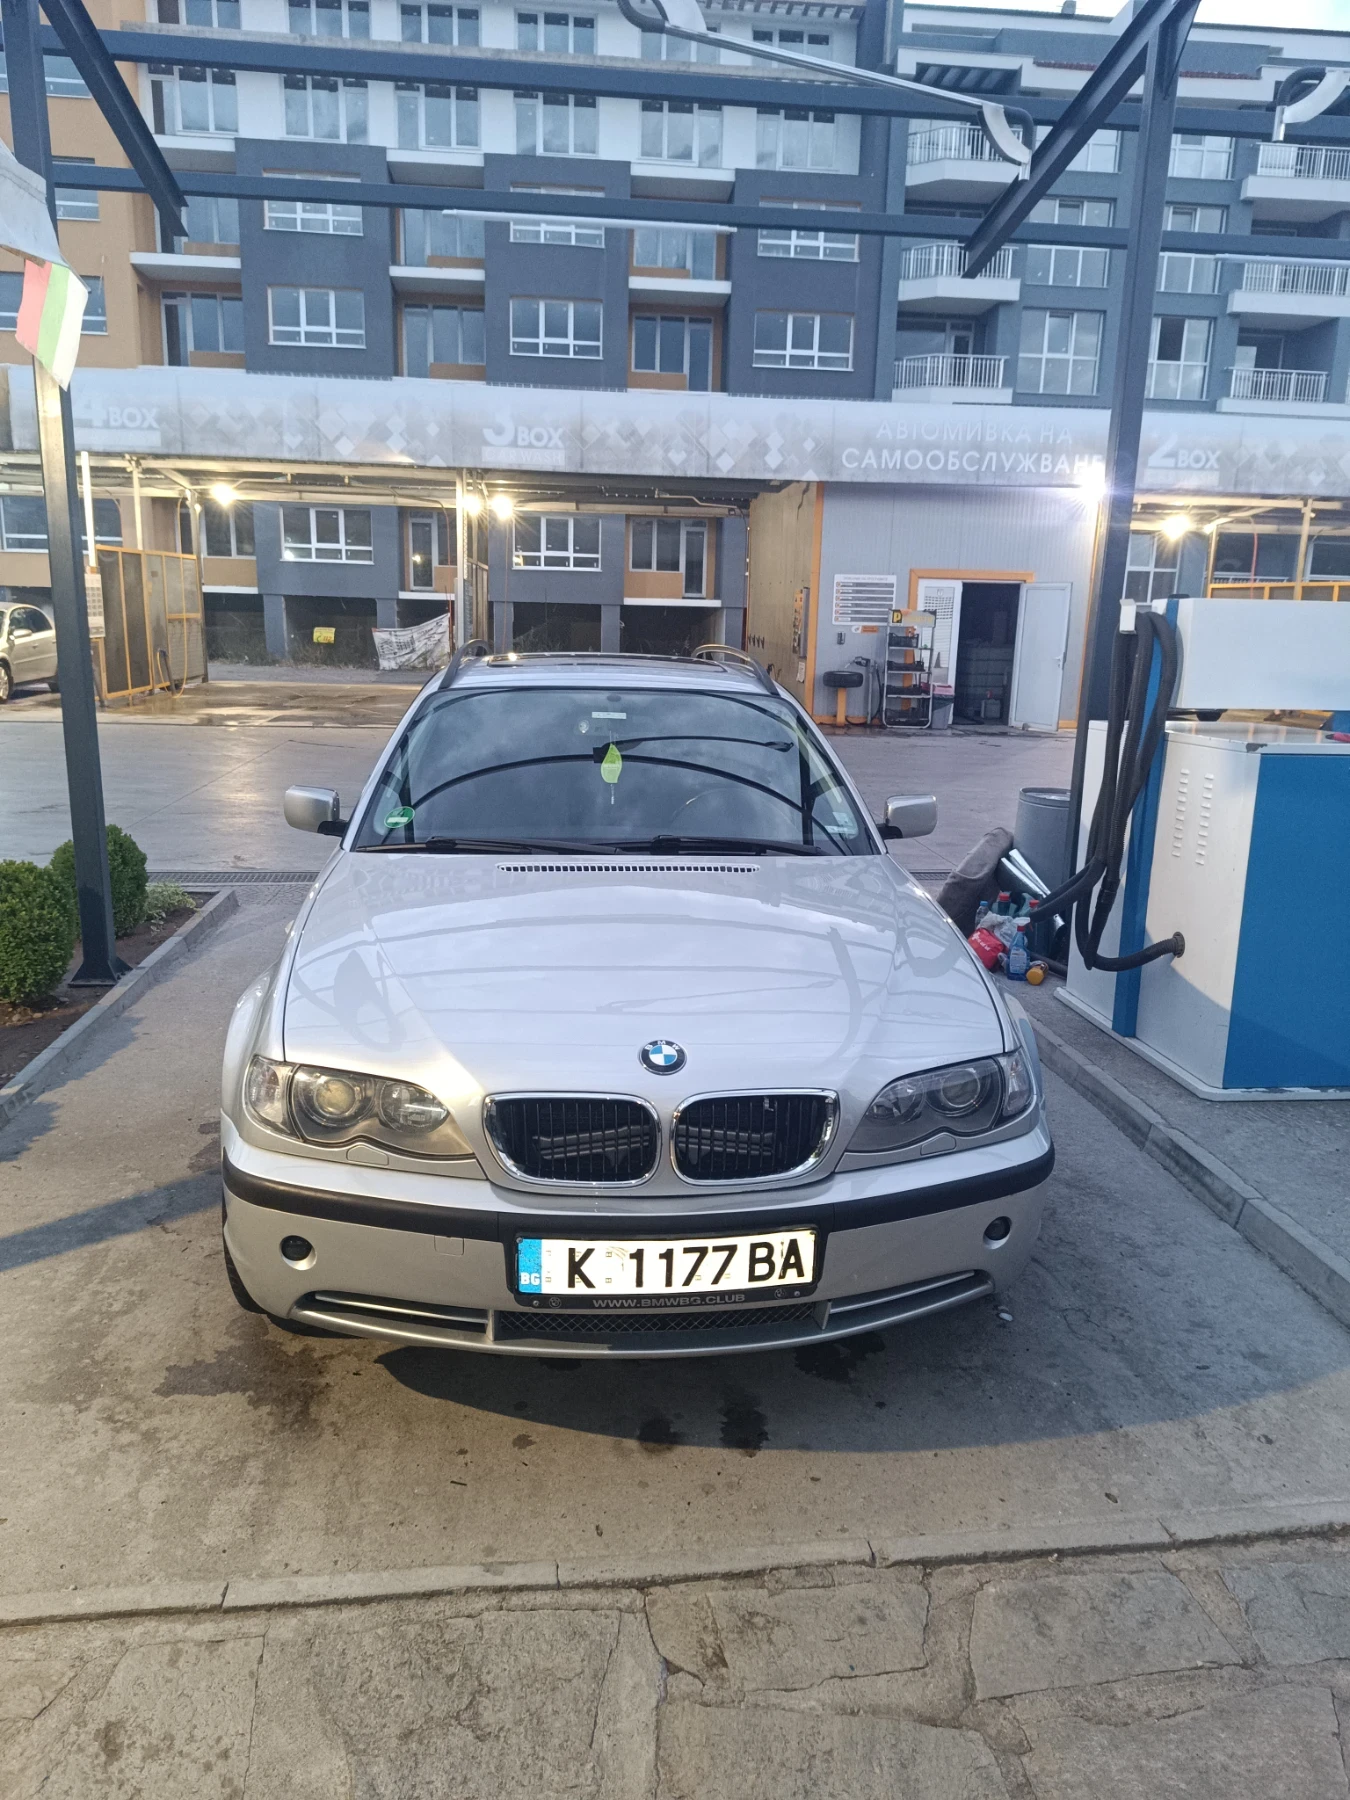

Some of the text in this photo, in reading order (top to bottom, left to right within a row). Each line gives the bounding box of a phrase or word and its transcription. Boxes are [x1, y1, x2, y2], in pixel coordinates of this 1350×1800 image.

[108, 407, 160, 428] BOX
[518, 427, 564, 448] BOX
[1039, 424, 1073, 445] НА
[519, 449, 565, 465] WASH
[1178, 449, 1222, 469] BOX
[644, 1040, 681, 1050] BMW
[567, 1238, 805, 1289] K 1177 BA
[520, 1272, 541, 1286] BG
[592, 1294, 746, 1309] WWW.BMWBG.CLUB
